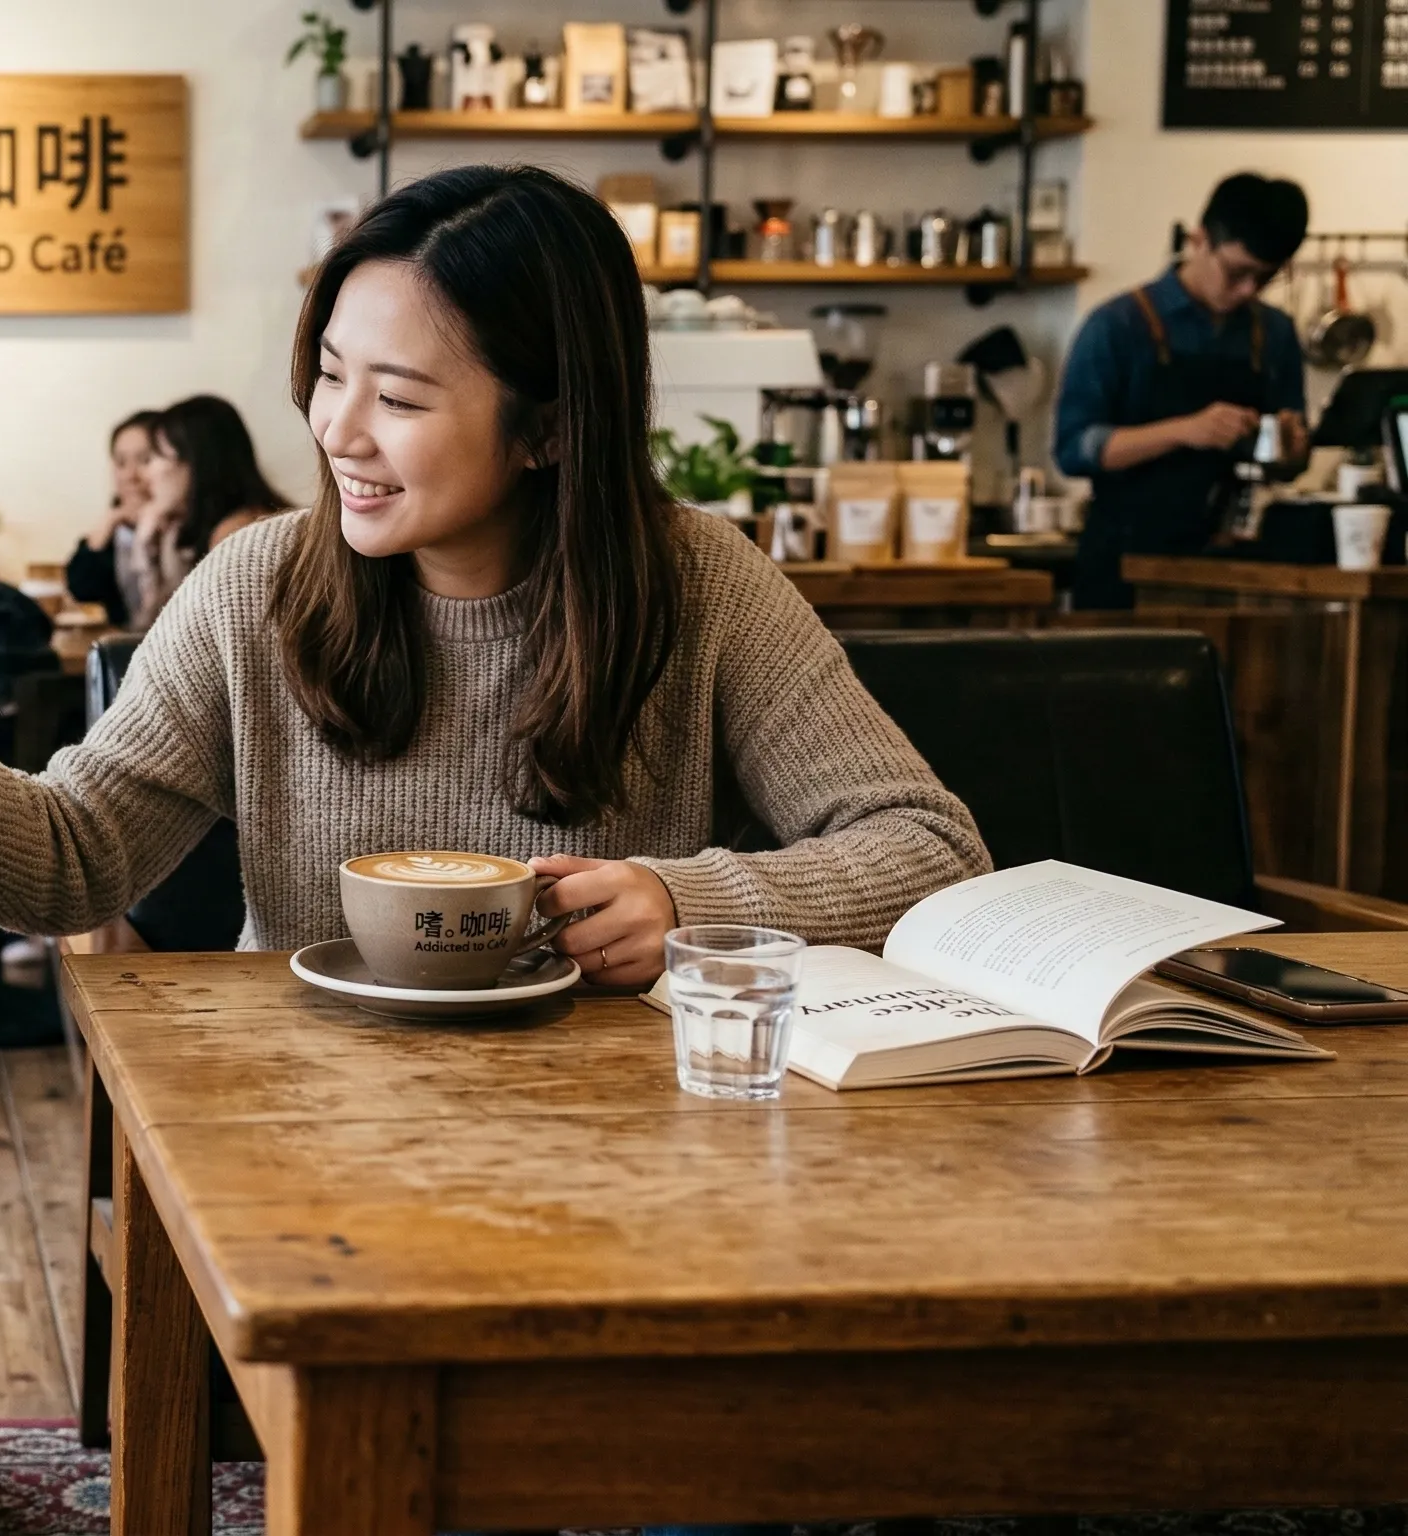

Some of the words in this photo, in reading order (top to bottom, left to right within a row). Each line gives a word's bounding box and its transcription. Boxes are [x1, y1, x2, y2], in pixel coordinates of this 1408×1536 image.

[31, 227, 129, 273] Café
[415, 908, 512, 939] 嗜。咖啡
[414, 941, 470, 953] Addicted
[473, 942, 485, 952] to
[950, 1007, 1024, 1018] The
